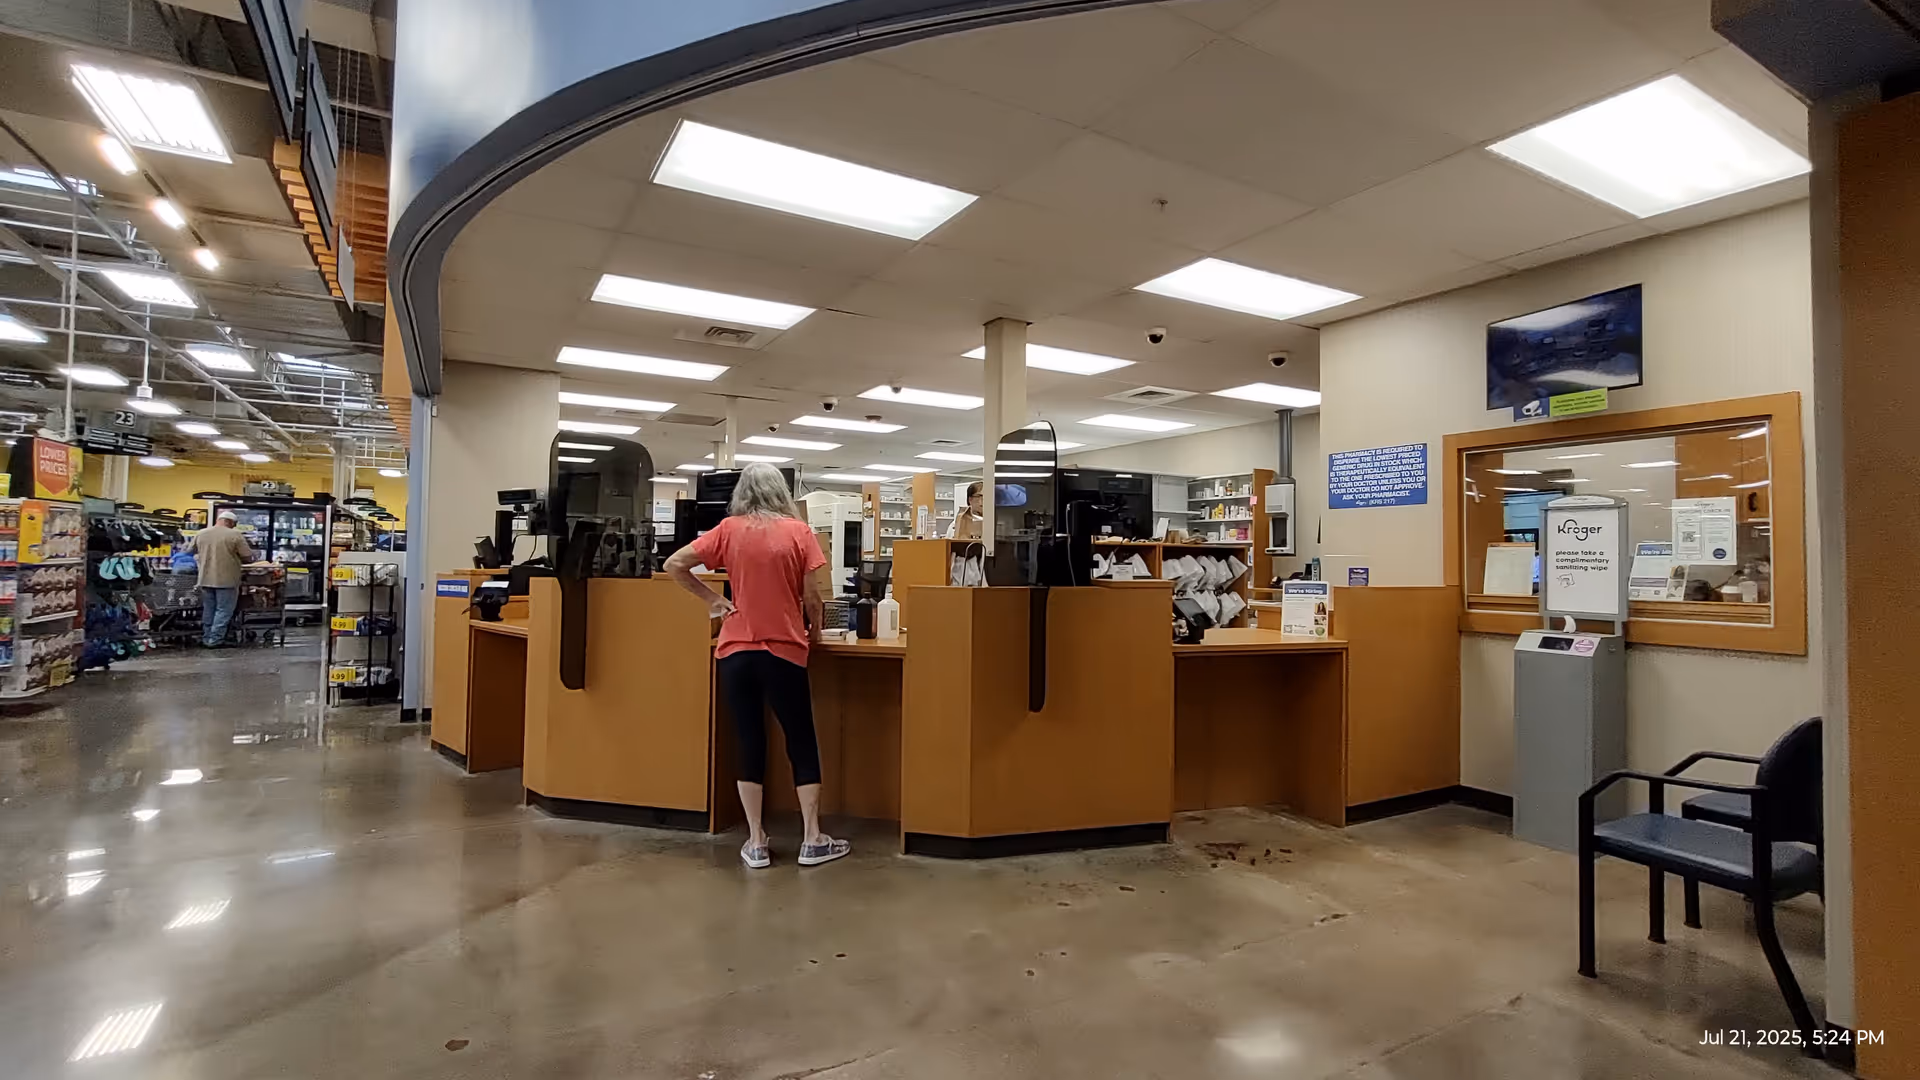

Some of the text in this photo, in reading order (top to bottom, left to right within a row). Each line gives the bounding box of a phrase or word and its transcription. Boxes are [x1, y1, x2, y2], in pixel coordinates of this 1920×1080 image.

[116, 412, 135, 425] 23
[40, 446, 66, 459] LOWER
[1345, 450, 1375, 458] PHARMACY
[1383, 446, 1413, 454] REQUIRED
[40, 460, 67, 476] PRICES
[1336, 466, 1387, 476] THERAPEUTICALLY
[1388, 463, 1425, 472] EQUIVALENT
[1364, 472, 1400, 480] PRESCRIBED
[1558, 519, 1602, 541] Kroger
